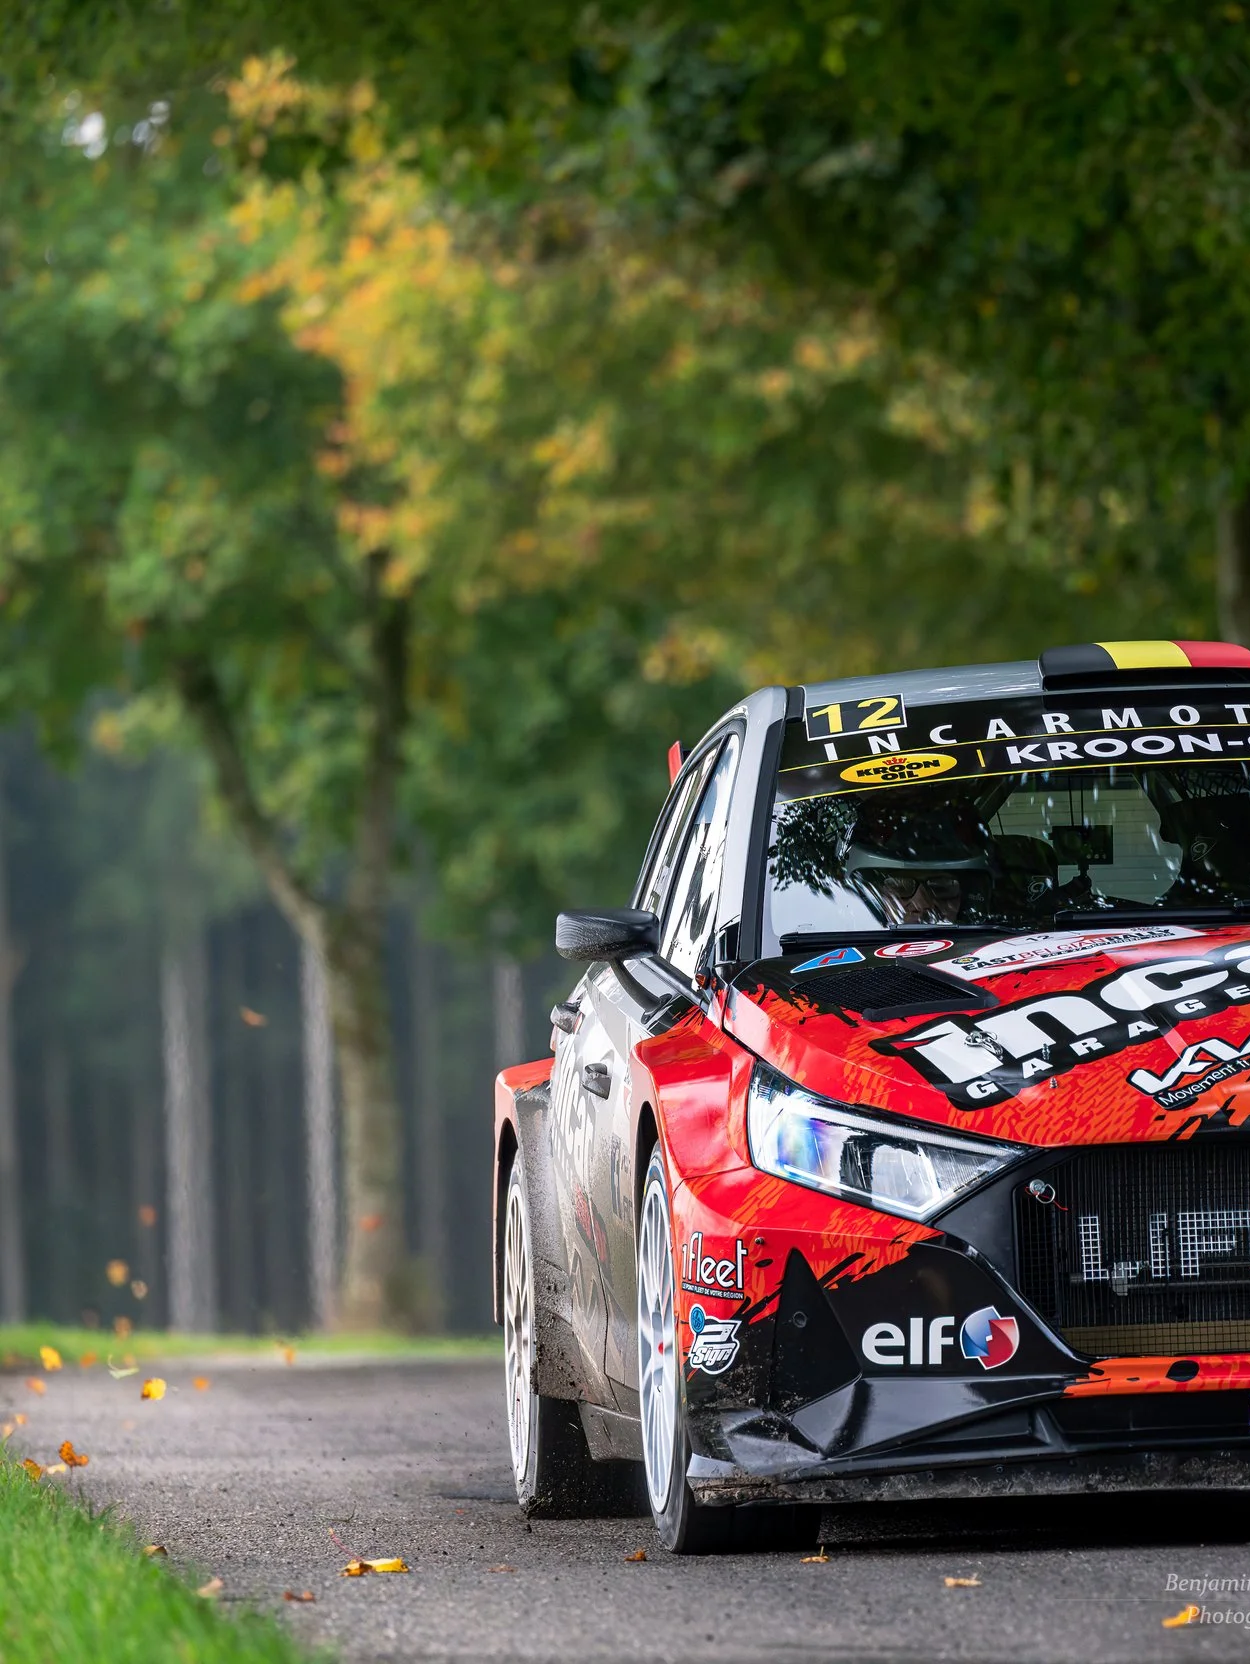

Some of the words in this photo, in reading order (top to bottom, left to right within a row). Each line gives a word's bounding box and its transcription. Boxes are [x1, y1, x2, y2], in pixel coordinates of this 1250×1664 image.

[811, 697, 902, 734] 12
[855, 760, 941, 778] KROON
[881, 771, 919, 781] OIL
[1159, 1063, 1237, 1105] Movement
[861, 1316, 955, 1365] elf
[692, 1347, 733, 1367] Sign
